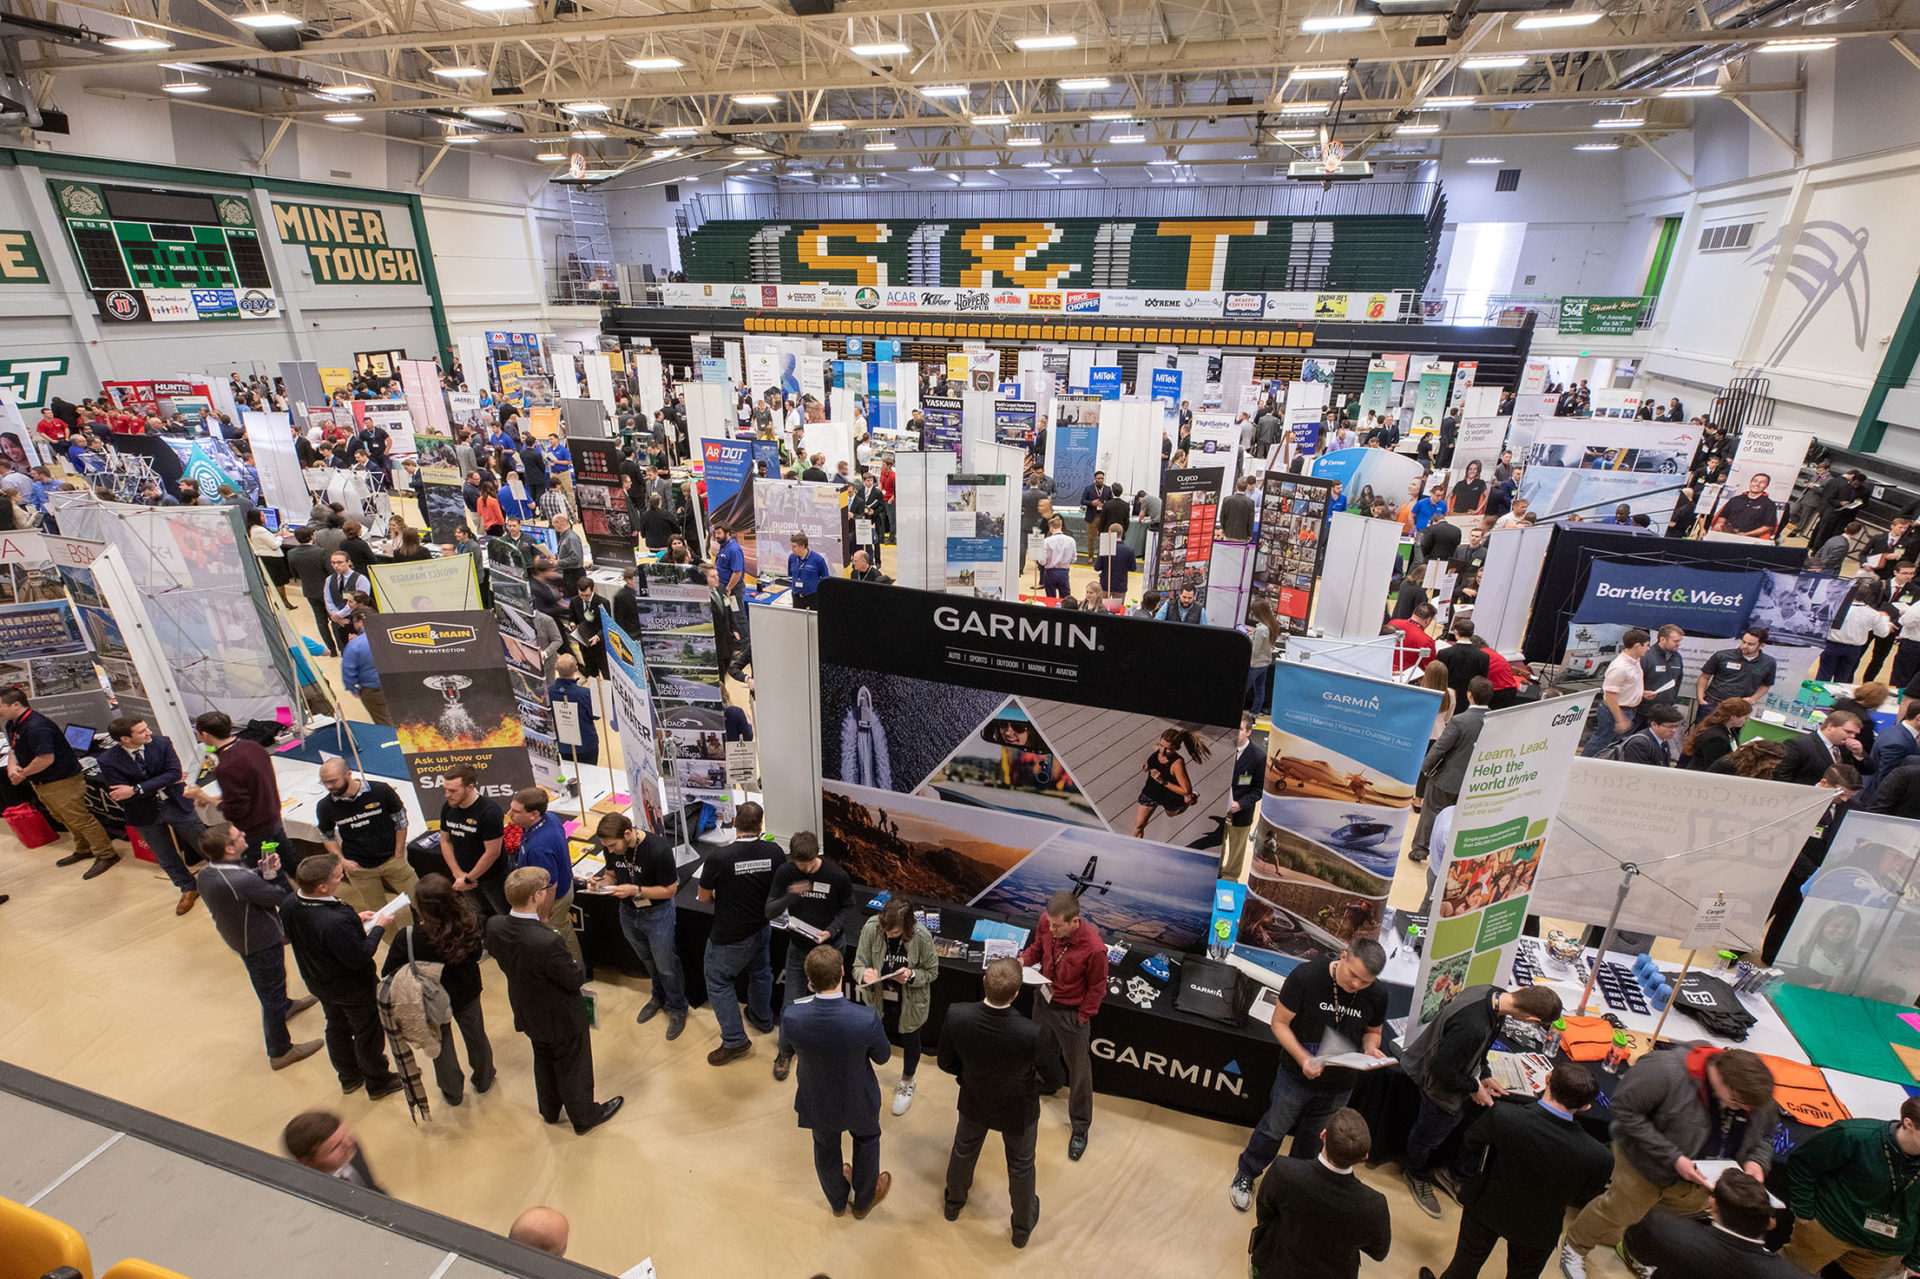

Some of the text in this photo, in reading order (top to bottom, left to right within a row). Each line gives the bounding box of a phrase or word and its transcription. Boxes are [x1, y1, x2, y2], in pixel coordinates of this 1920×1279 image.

[272, 204, 386, 245] MINER
[310, 247, 418, 281] TOUGH
[821, 287, 847, 297] Randy's
[887, 291, 916, 302] ACAR
[1069, 293, 1087, 302] PRICE
[240, 299, 276, 310] GLVC
[954, 292, 990, 311] HOPPERS
[1029, 294, 1062, 305] LEE'S
[1067, 299, 1100, 312] CHOPPER
[1144, 298, 1181, 308] EXTREME
[1370, 303, 1385, 318] 8
[1562, 303, 1588, 317] S&T
[1588, 300, 1641, 314] Thank You!
[1093, 371, 1117, 381] MiTek
[1155, 373, 1177, 384] MiTek
[154, 383, 190, 392] HUNTER
[925, 399, 962, 409] YASKAWA
[1195, 419, 1230, 429] FlightSafety
[1466, 422, 1491, 430] Become
[1747, 431, 1784, 442] Become
[1743, 445, 1776, 455] of steel.
[66, 543, 96, 564] BSA
[1596, 582, 1743, 607] Bartlett&West
[646, 618, 689, 626] PEDESTRIAN
[393, 629, 471, 640] CORE&MAIN
[948, 652, 1078, 677] AUTO SPORTS OUTDOOR MARINE AVIATION
[612, 676, 635, 713] CLEAN
[1322, 691, 1380, 711] GARMIN
[622, 701, 652, 742] WATER
[1552, 708, 1585, 726] Cargill
[1285, 711, 1412, 747] Aviation Marine Fitness Outdoor Auto
[1477, 737, 1549, 763] Learn, Lead,
[414, 757, 434, 765] Ask
[450, 754, 473, 762] how
[475, 753, 493, 761] our
[1472, 760, 1524, 778] Help the
[1469, 770, 1538, 793] world thrive
[350, 819, 370, 829] Program
[1190, 983, 1223, 998] GARMIN
[1090, 1038, 1244, 1097] GARMIN
[1786, 1101, 1834, 1120] Cargill
